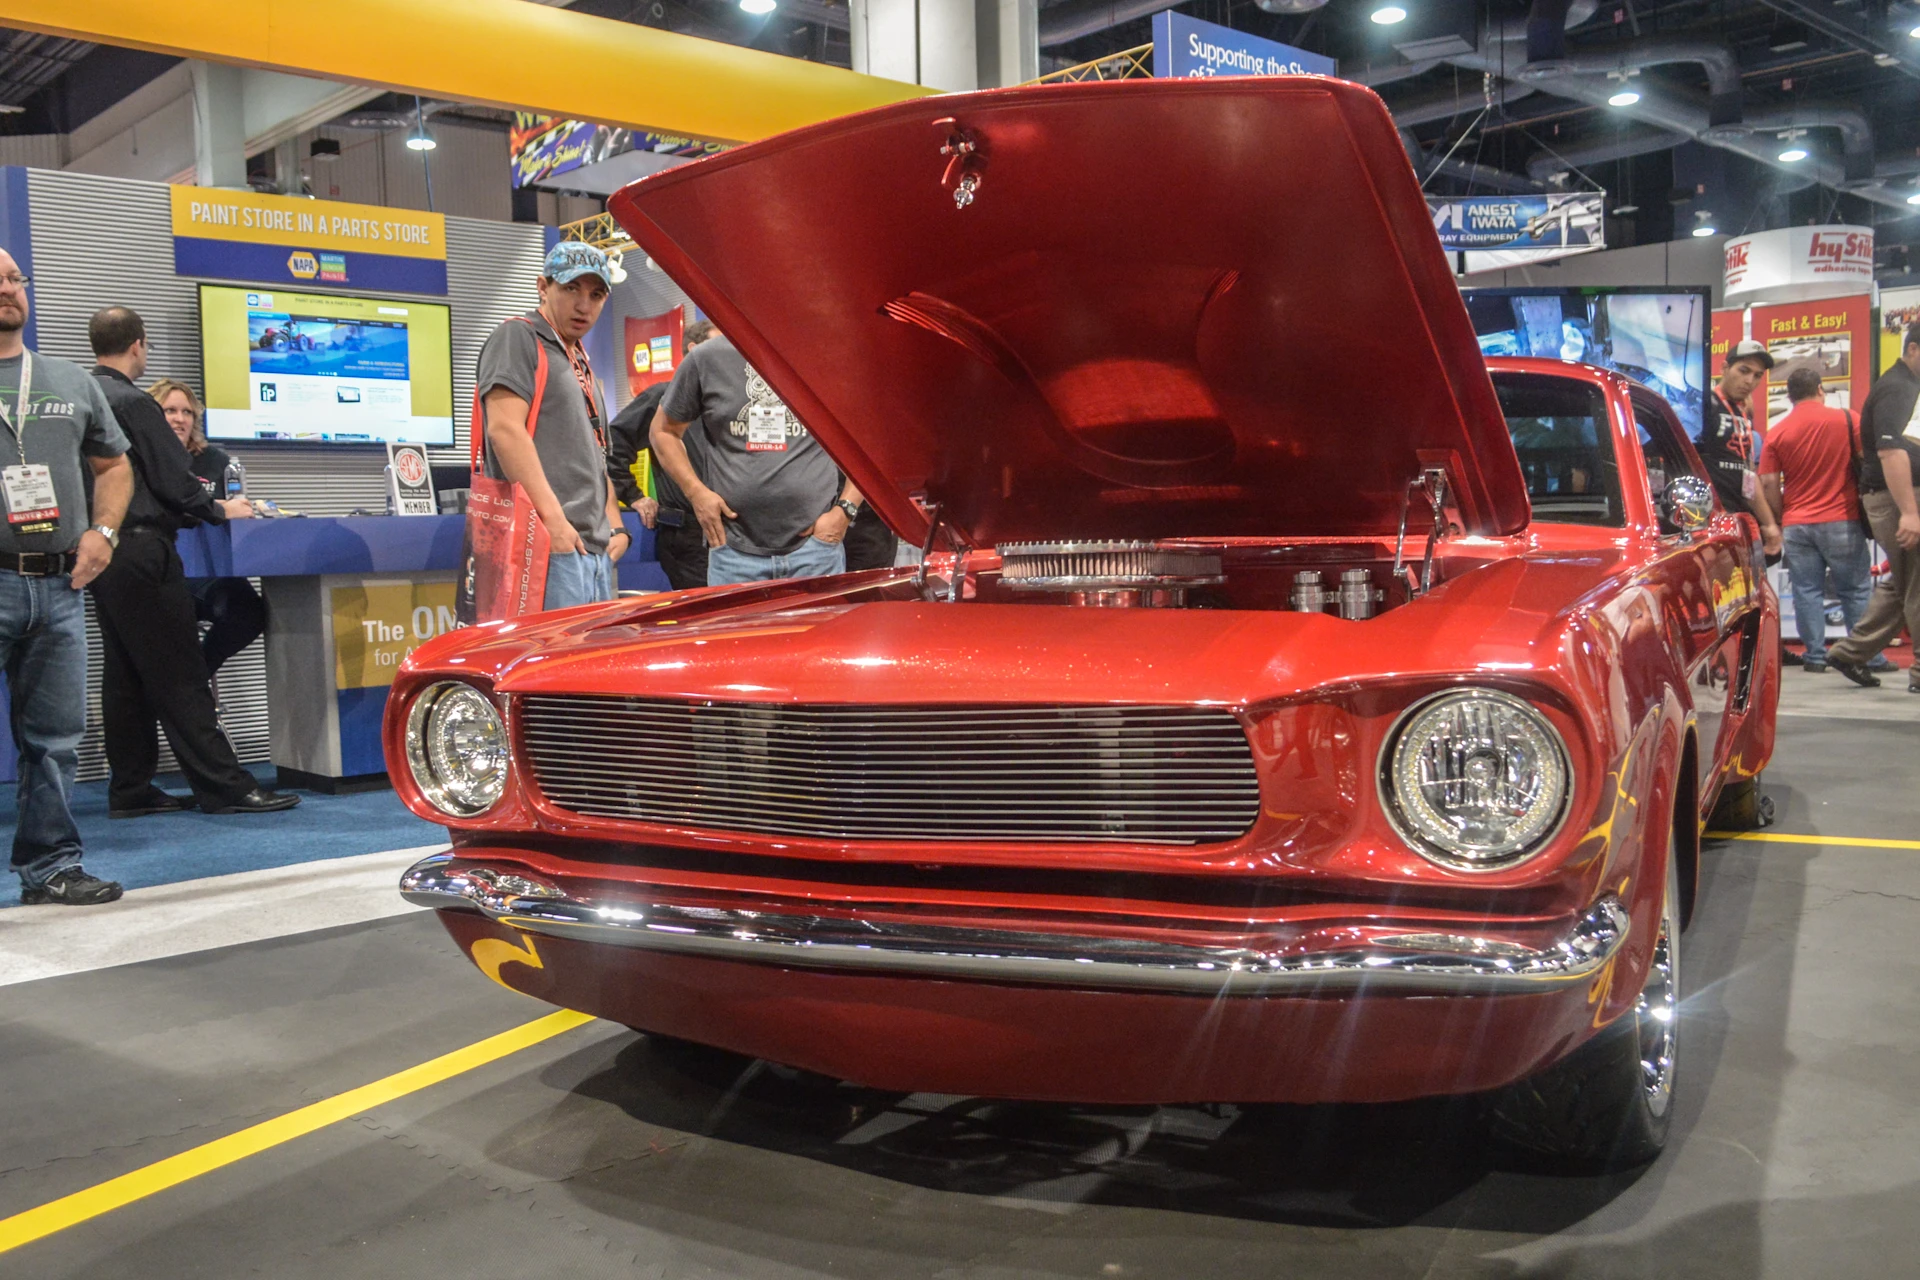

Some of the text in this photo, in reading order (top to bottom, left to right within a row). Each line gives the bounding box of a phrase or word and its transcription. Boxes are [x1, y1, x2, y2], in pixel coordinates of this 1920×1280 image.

[1189, 33, 1264, 75] Supporting
[1267, 56, 1288, 75] the
[552, 139, 586, 169] Shine!
[1468, 203, 1519, 216] ANEST
[191, 201, 429, 244] PAINT STORE IN A PARTS STORE
[1472, 215, 1516, 229] IWATA
[1460, 232, 1519, 242] EQUIPMENT
[293, 257, 315, 272] NAPA
[566, 252, 604, 271] NAVY
[1814, 263, 1856, 273] adhesive
[1771, 312, 1847, 333] Fast & Easy!
[44, 403, 75, 415] RODS
[404, 501, 431, 513] MEMBER
[13, 509, 55, 521] BUYER-14
[362, 620, 405, 642] The
[374, 648, 398, 666] for
